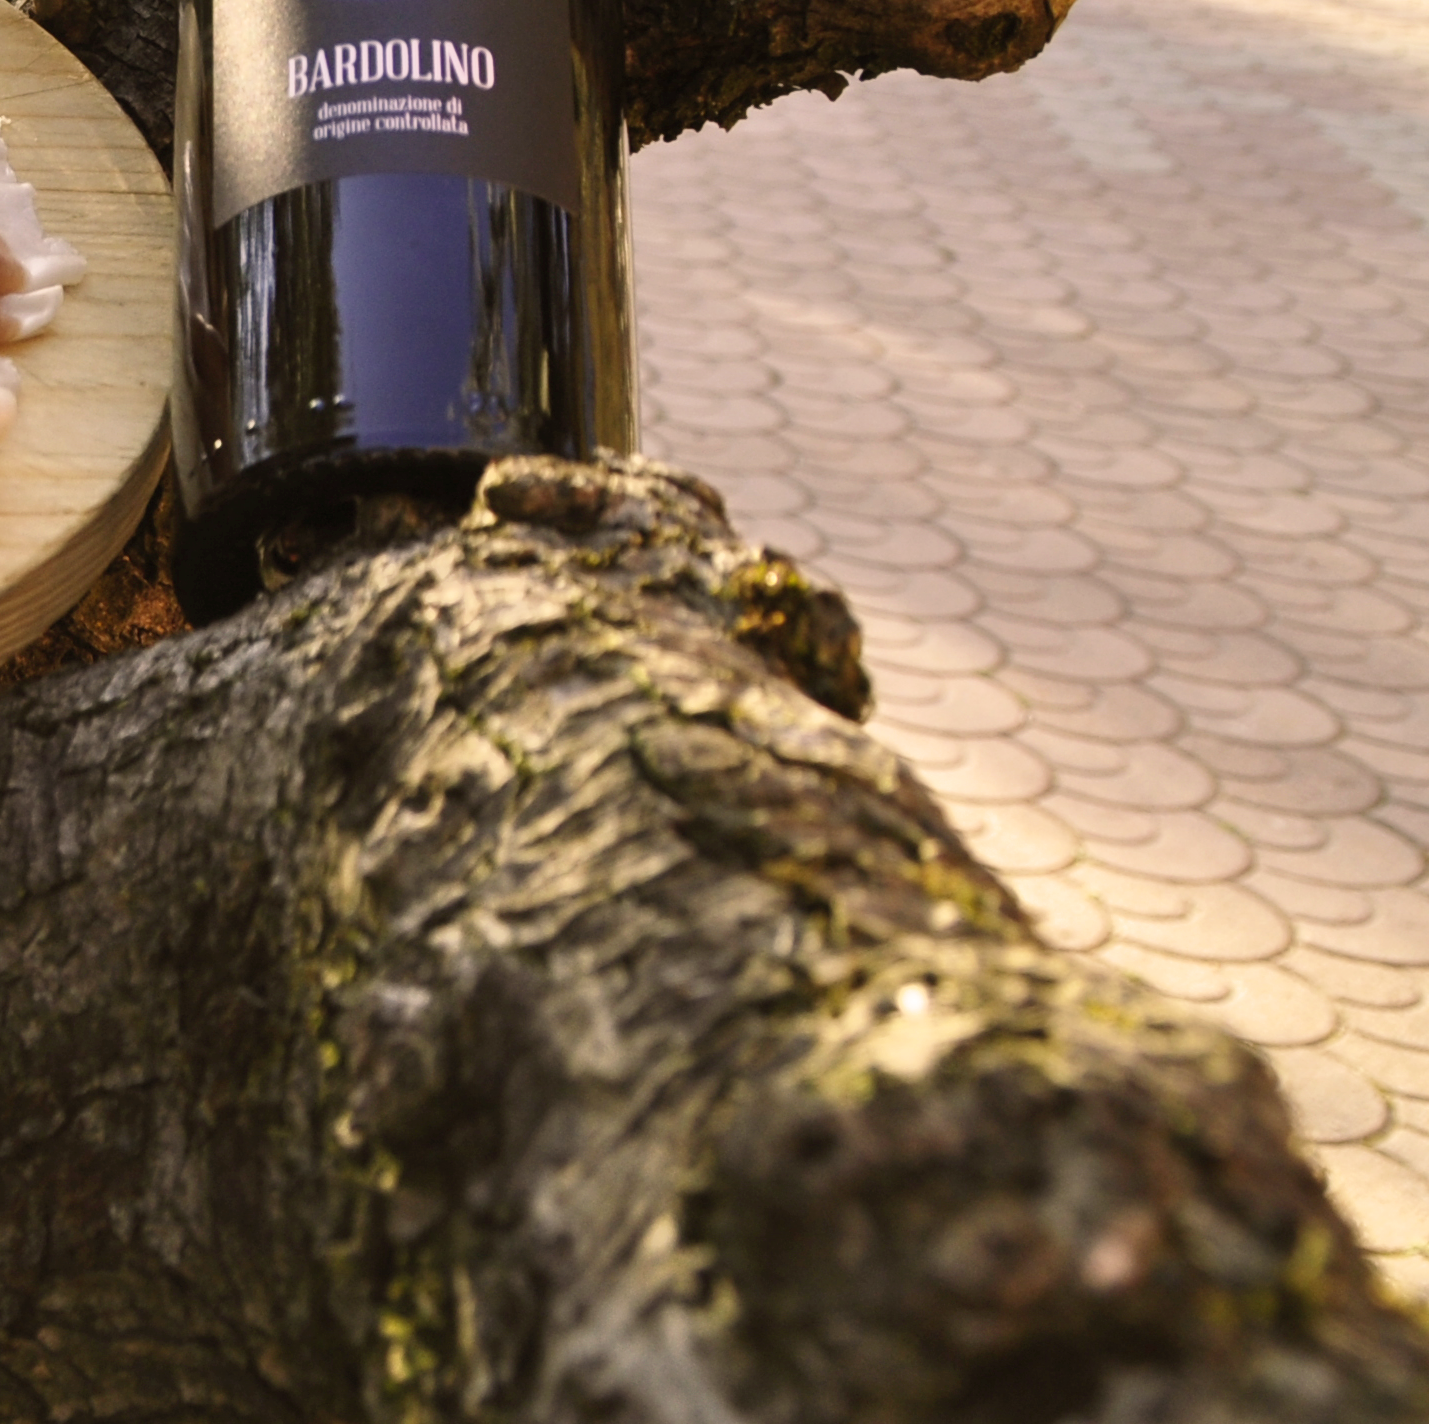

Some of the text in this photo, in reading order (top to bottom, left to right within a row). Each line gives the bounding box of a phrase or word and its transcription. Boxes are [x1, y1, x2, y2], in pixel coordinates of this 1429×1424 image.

[288, 38, 495, 98] BARDOLINO
[318, 95, 463, 121] denominazione di
[313, 112, 469, 140] origine controllata
